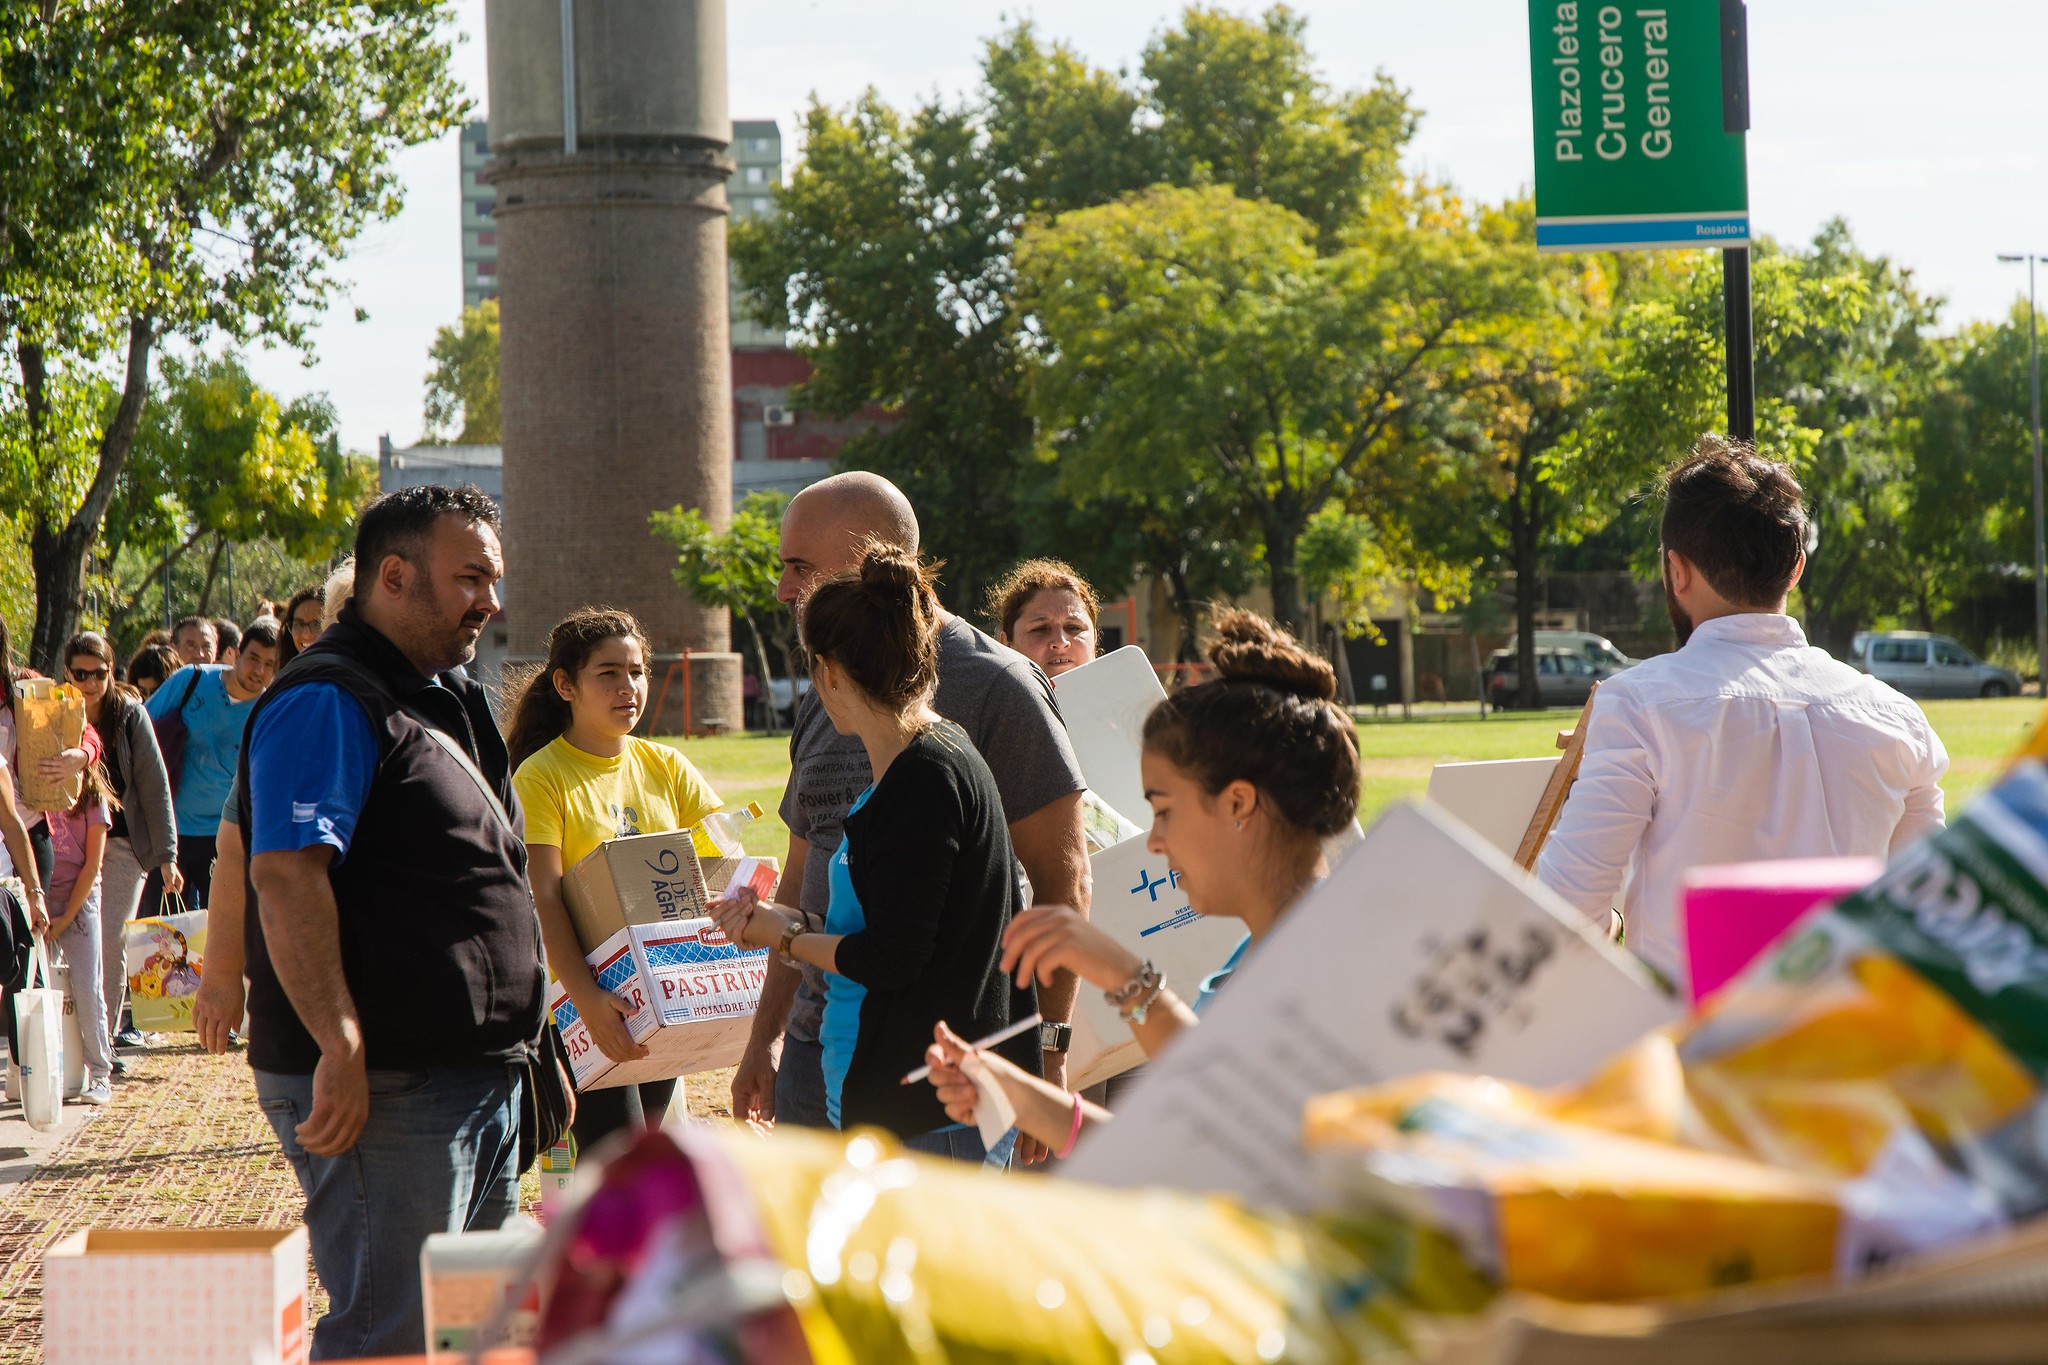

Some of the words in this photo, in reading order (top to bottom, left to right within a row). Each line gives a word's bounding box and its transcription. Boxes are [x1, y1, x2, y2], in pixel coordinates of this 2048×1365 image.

[1552, 0, 1583, 161] Plazoleta
[1594, 6, 1627, 161] Crucero
[1636, 8, 1672, 159] General
[1696, 224, 1738, 236] Rosario
[798, 791, 842, 809] Power
[644, 849, 679, 875] 9
[651, 880, 680, 921] AGRI
[670, 880, 690, 903] DE
[693, 1001, 745, 1017] HOJALDRE
